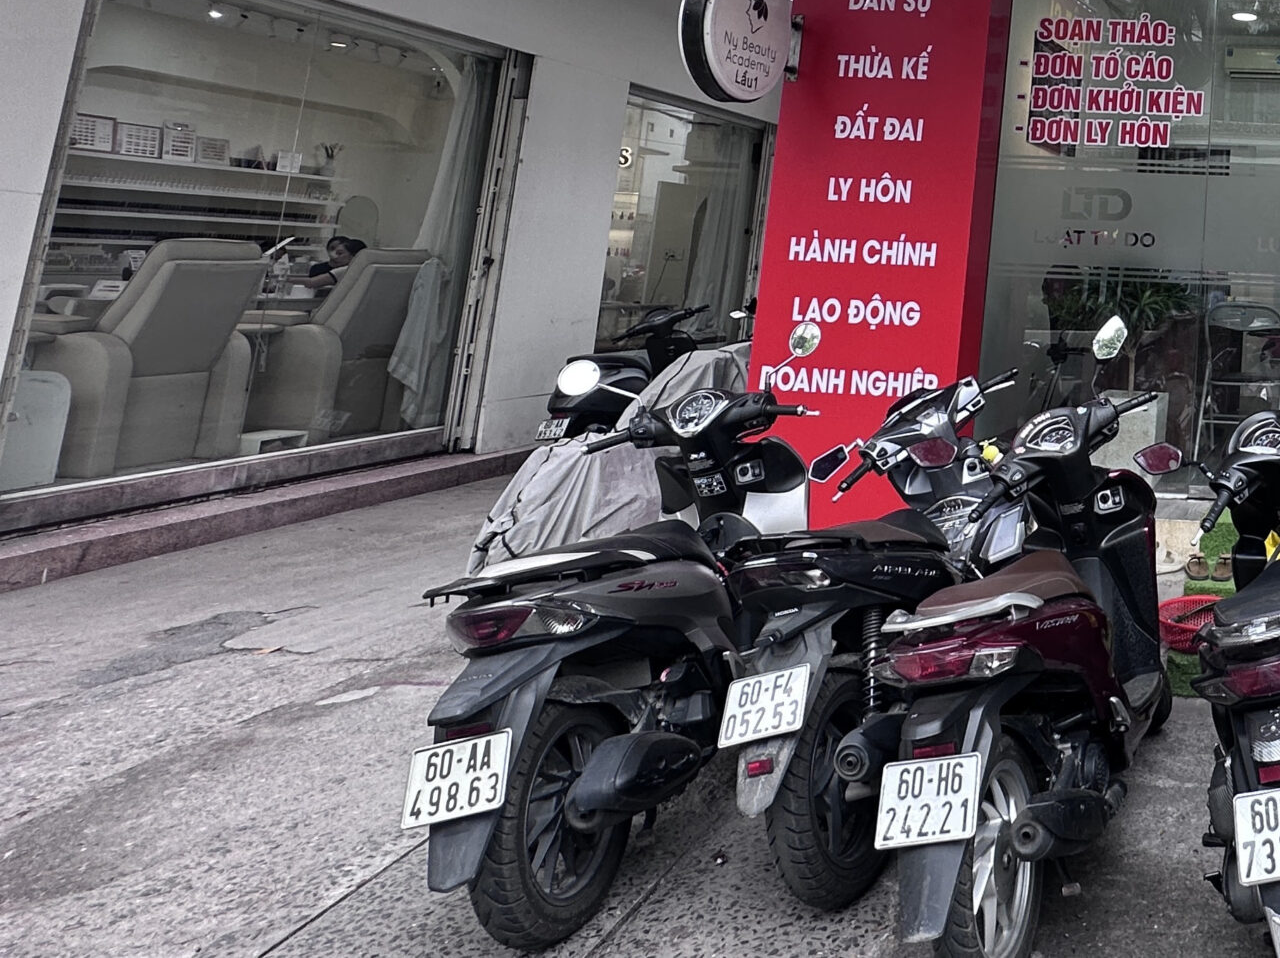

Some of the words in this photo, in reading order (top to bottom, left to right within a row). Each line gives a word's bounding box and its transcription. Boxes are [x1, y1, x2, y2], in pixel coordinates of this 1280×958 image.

[724, 30, 739, 51] Ny
[742, 36, 777, 63] Beauty
[1038, 18, 1102, 46] SOẠN
[1108, 13, 1175, 46] THẢO:
[725, 49, 770, 77] Academy
[837, 45, 893, 79] THỪA
[901, 45, 932, 79] KẾ
[1034, 52, 1083, 78] ĐƠN
[1092, 48, 1122, 80] TỐ
[1125, 51, 1173, 81] CÁO
[1032, 84, 1081, 111] ĐƠN
[1086, 82, 1143, 113] KHỞI
[1147, 86, 1203, 120] KIỆN
[834, 103, 878, 139] ĐẤT
[883, 117, 924, 142] ĐAI
[1030, 116, 1080, 144] ĐƠN
[1085, 119, 1113, 144] LY
[1119, 116, 1170, 147] HÔN
[827, 177, 852, 201] LY
[859, 172, 912, 203] HÔN
[789, 230, 857, 263] HÀNH
[862, 234, 937, 267] CHÍNH
[1124, 232, 1156, 248] DO
[792, 297, 841, 323] LAO
[848, 294, 921, 330] ĐỘNG
[759, 365, 845, 394] DOANH
[737, 680, 793, 709] 60-F4
[724, 700, 800, 740] 052.53
[425, 739, 492, 783] 60-AA
[409, 773, 499, 820] 498.63
[897, 762, 963, 799] 60-H6
[883, 797, 970, 841] 242.21
